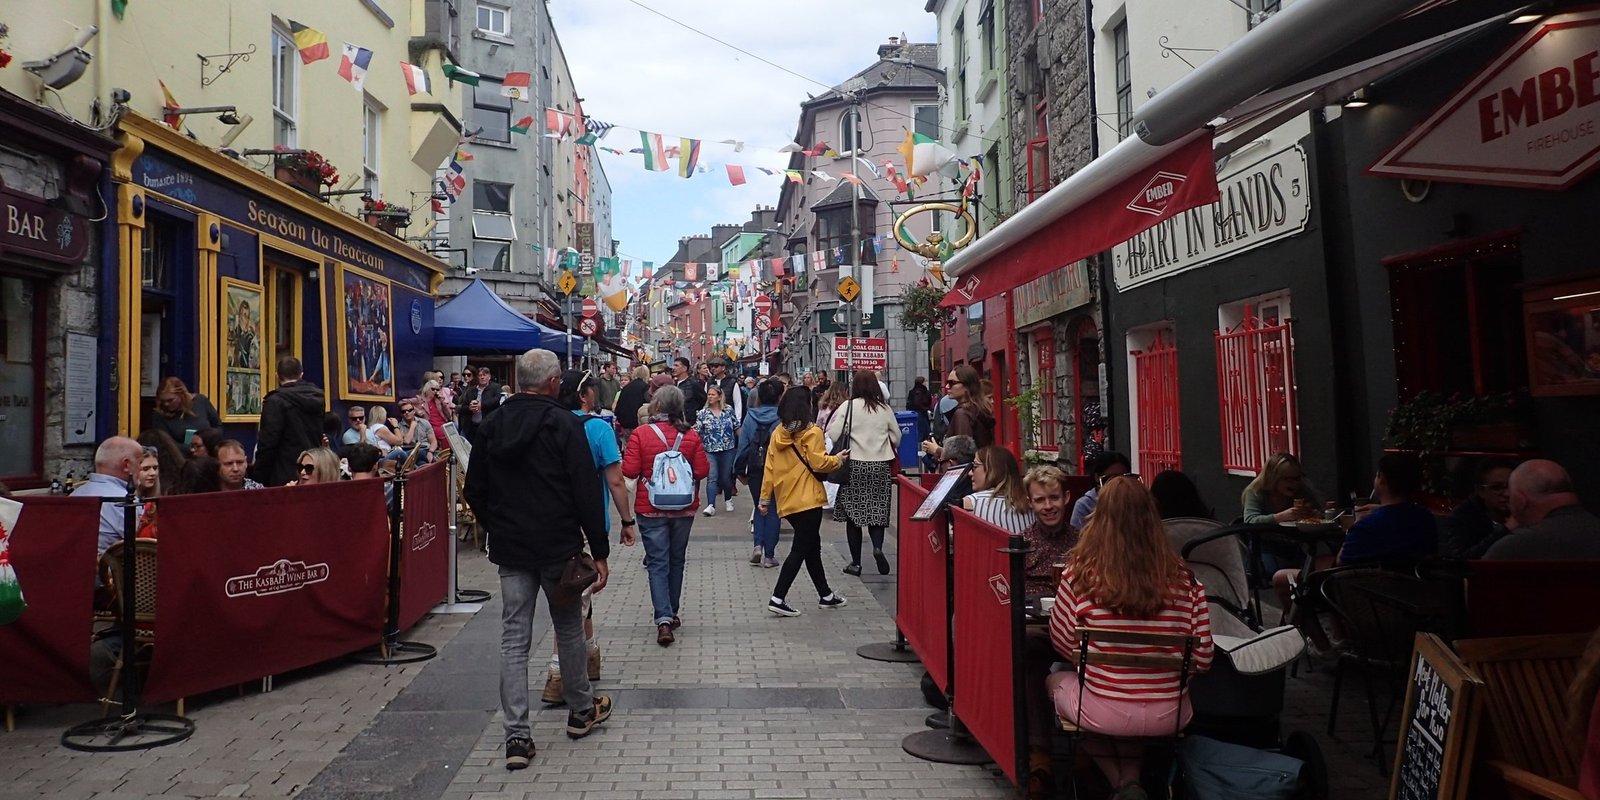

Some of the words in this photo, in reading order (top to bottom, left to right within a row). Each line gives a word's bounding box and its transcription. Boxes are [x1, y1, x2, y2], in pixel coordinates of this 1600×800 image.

[1527, 120, 1595, 154] FIREHOUSE
[1146, 182, 1174, 203] EMBER
[7, 204, 48, 241] BAR
[1125, 215, 1179, 279] HEART
[1184, 206, 1206, 258] IN
[1213, 163, 1287, 248] HANDS
[1291, 178, 1301, 198] 5
[311, 226, 329, 250] Ua
[238, 580, 253, 591] THE
[255, 576, 285, 588] KASBAH
[286, 572, 306, 582] WINE
[307, 569, 318, 579] BAR
